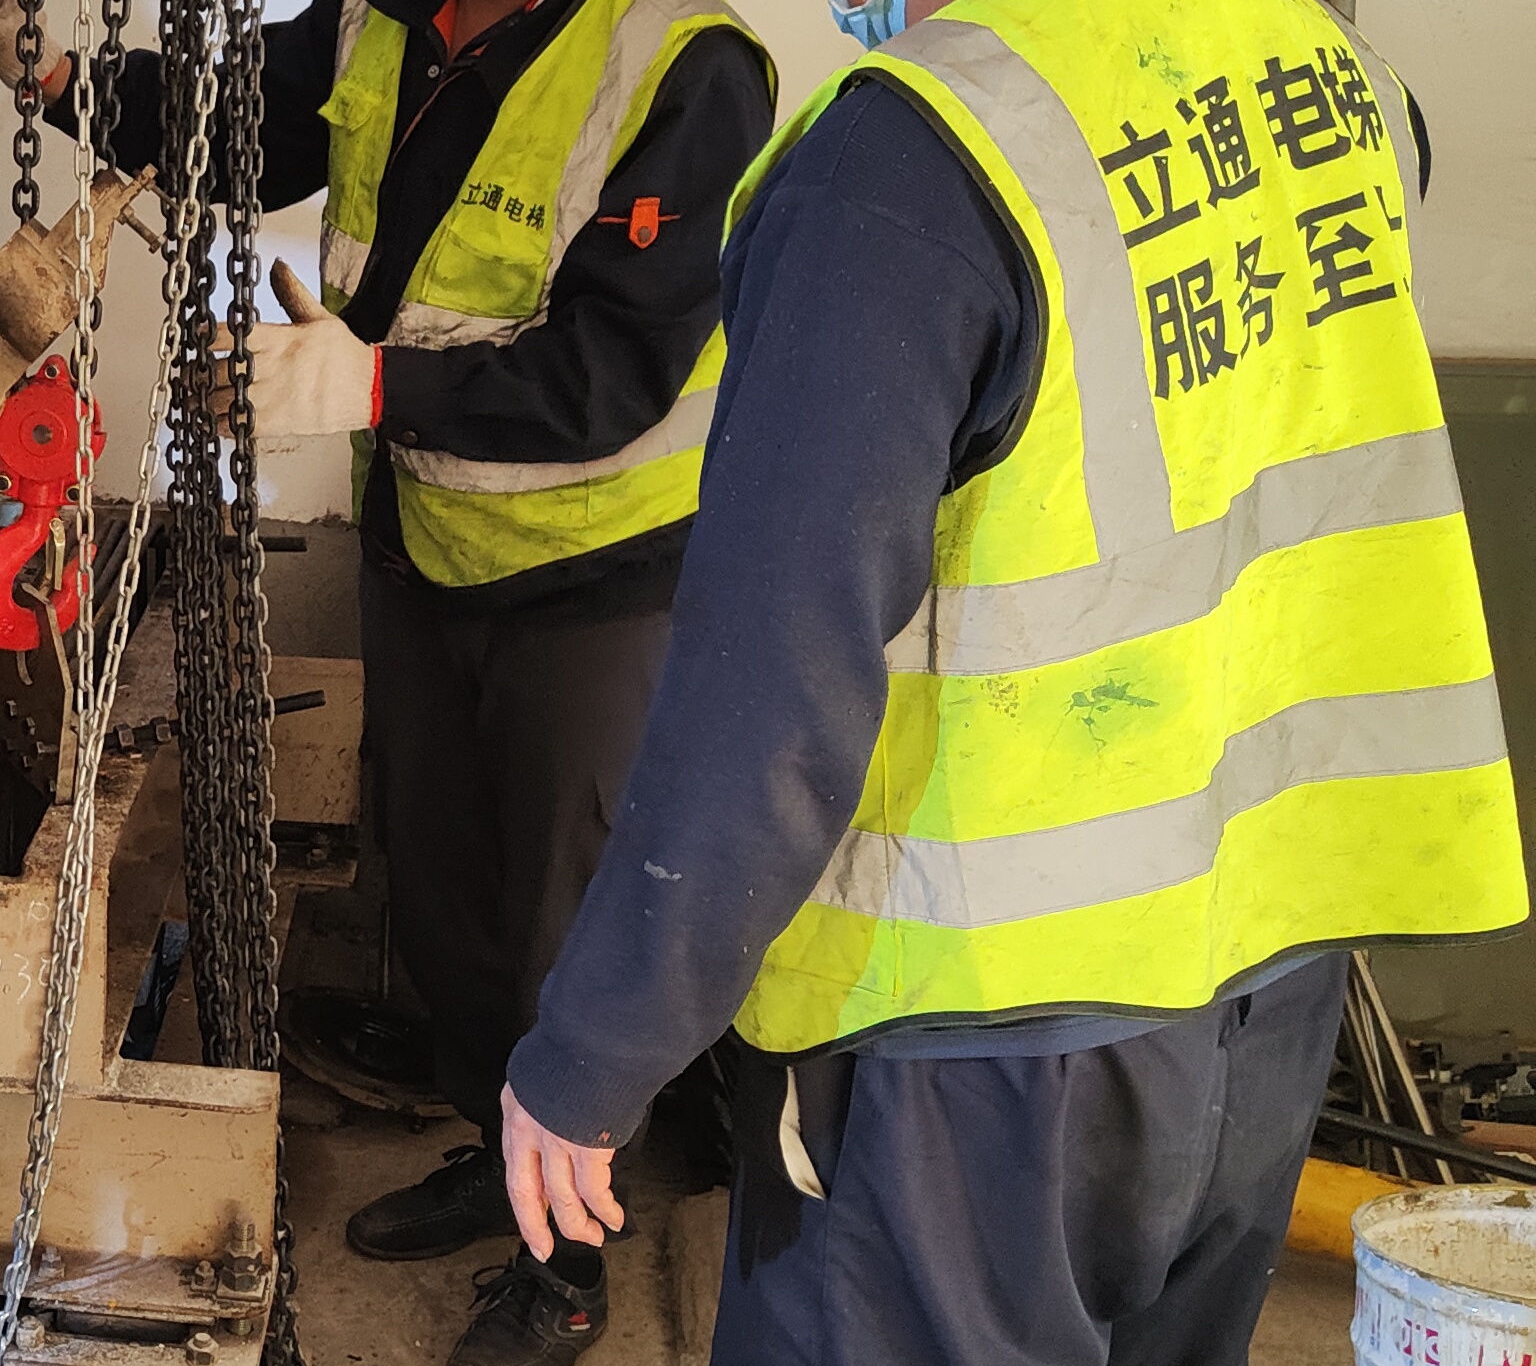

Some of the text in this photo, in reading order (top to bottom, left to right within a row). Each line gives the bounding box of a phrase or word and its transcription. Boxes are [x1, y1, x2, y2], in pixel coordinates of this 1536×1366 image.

[461, 182, 547, 231] 立通电梯
[1099, 44, 1384, 250] 立通电梯
